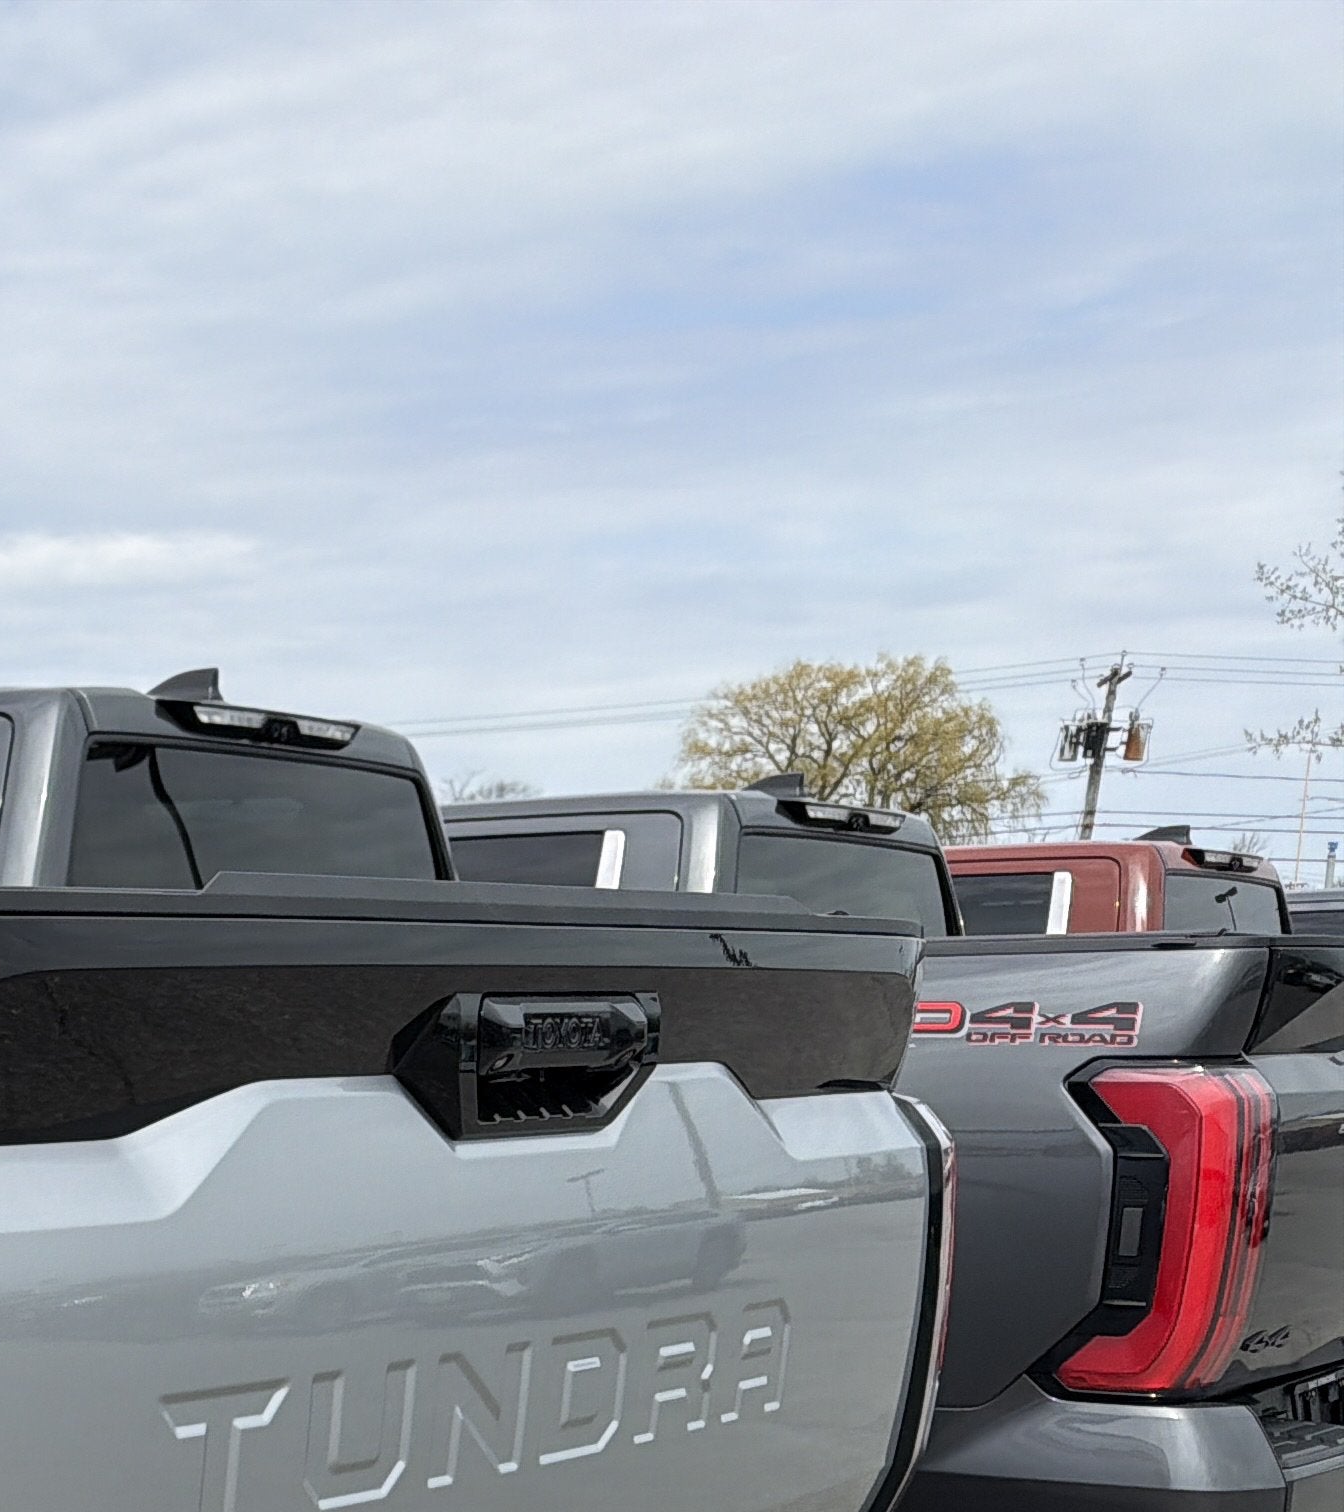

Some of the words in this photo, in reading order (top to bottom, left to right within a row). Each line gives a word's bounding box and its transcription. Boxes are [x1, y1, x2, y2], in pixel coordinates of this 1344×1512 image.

[525, 1017, 609, 1049] TOYOTA
[965, 1031, 1034, 1046] OFF
[1038, 1031, 1139, 1048] ROAD
